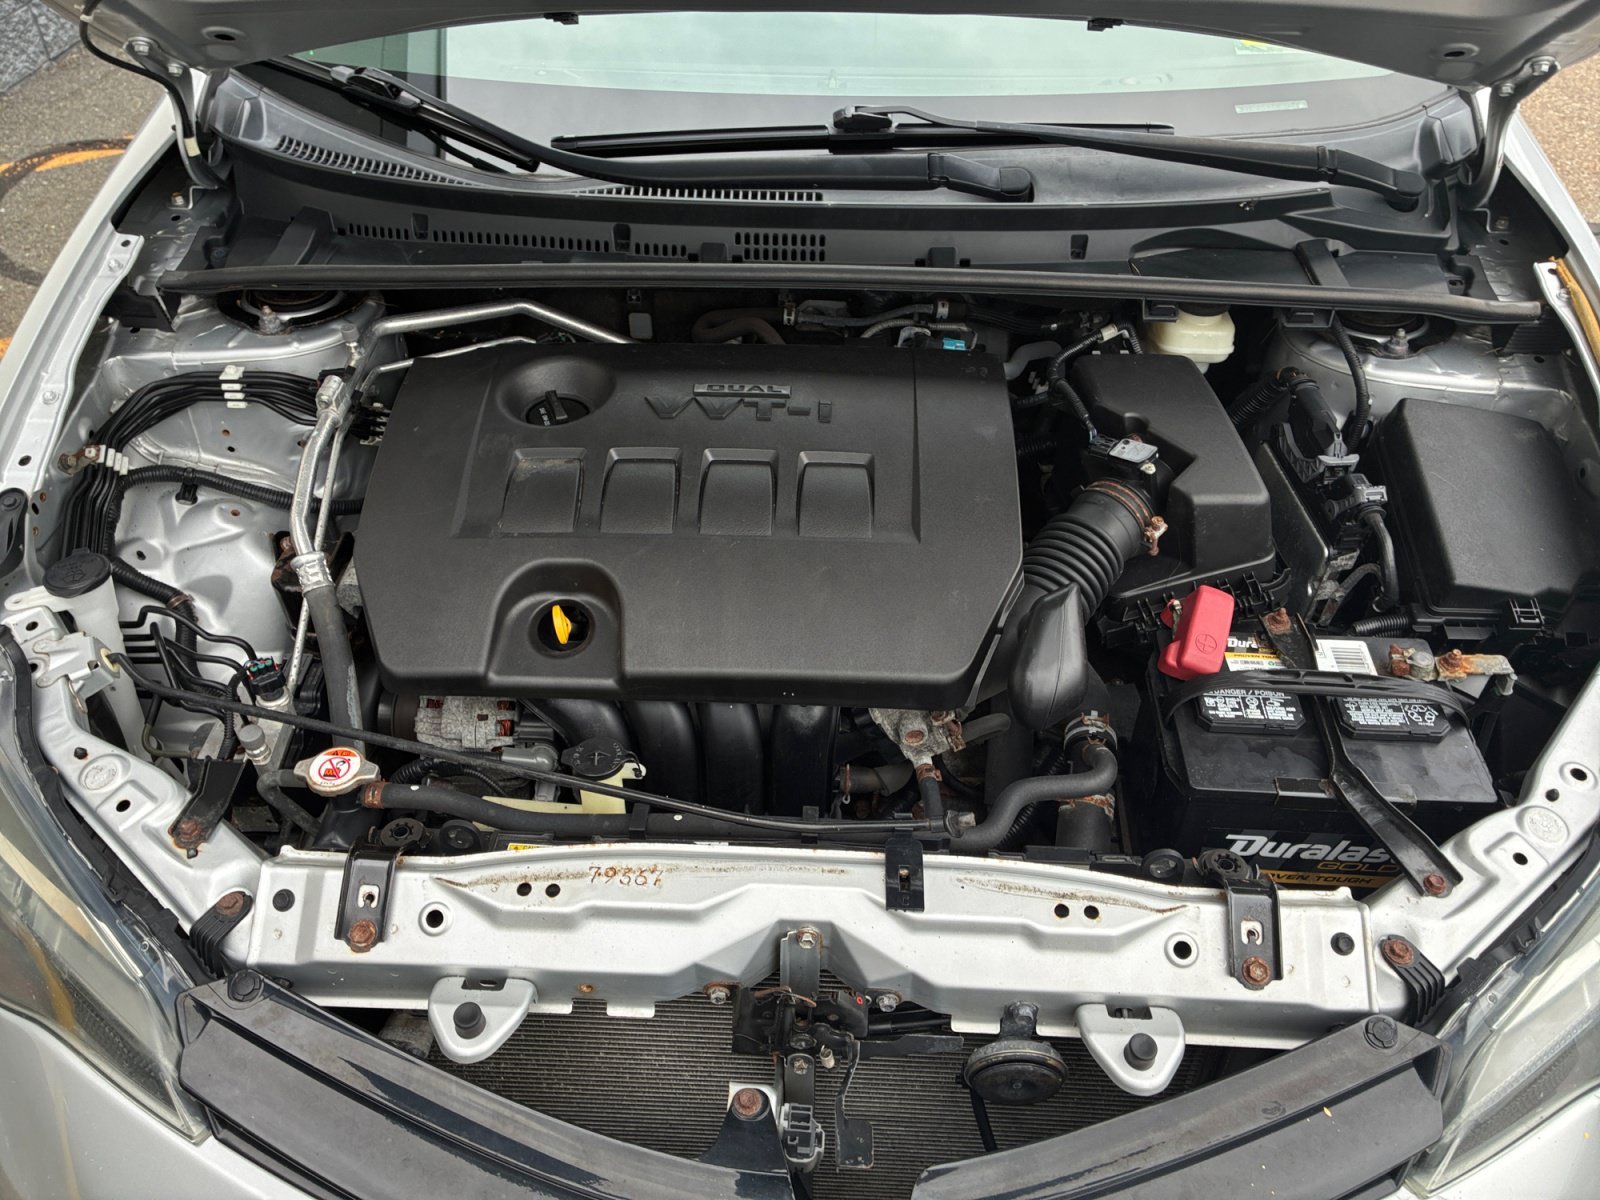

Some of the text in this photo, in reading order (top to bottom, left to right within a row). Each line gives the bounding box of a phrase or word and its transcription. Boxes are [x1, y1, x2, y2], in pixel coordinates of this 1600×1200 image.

[706, 383, 783, 394] DUAL
[1227, 637, 1258, 649] Dura
[1225, 833, 1396, 863] Duralas
[1317, 861, 1400, 873] GOLD
[1315, 875, 1375, 884] TOUGH
